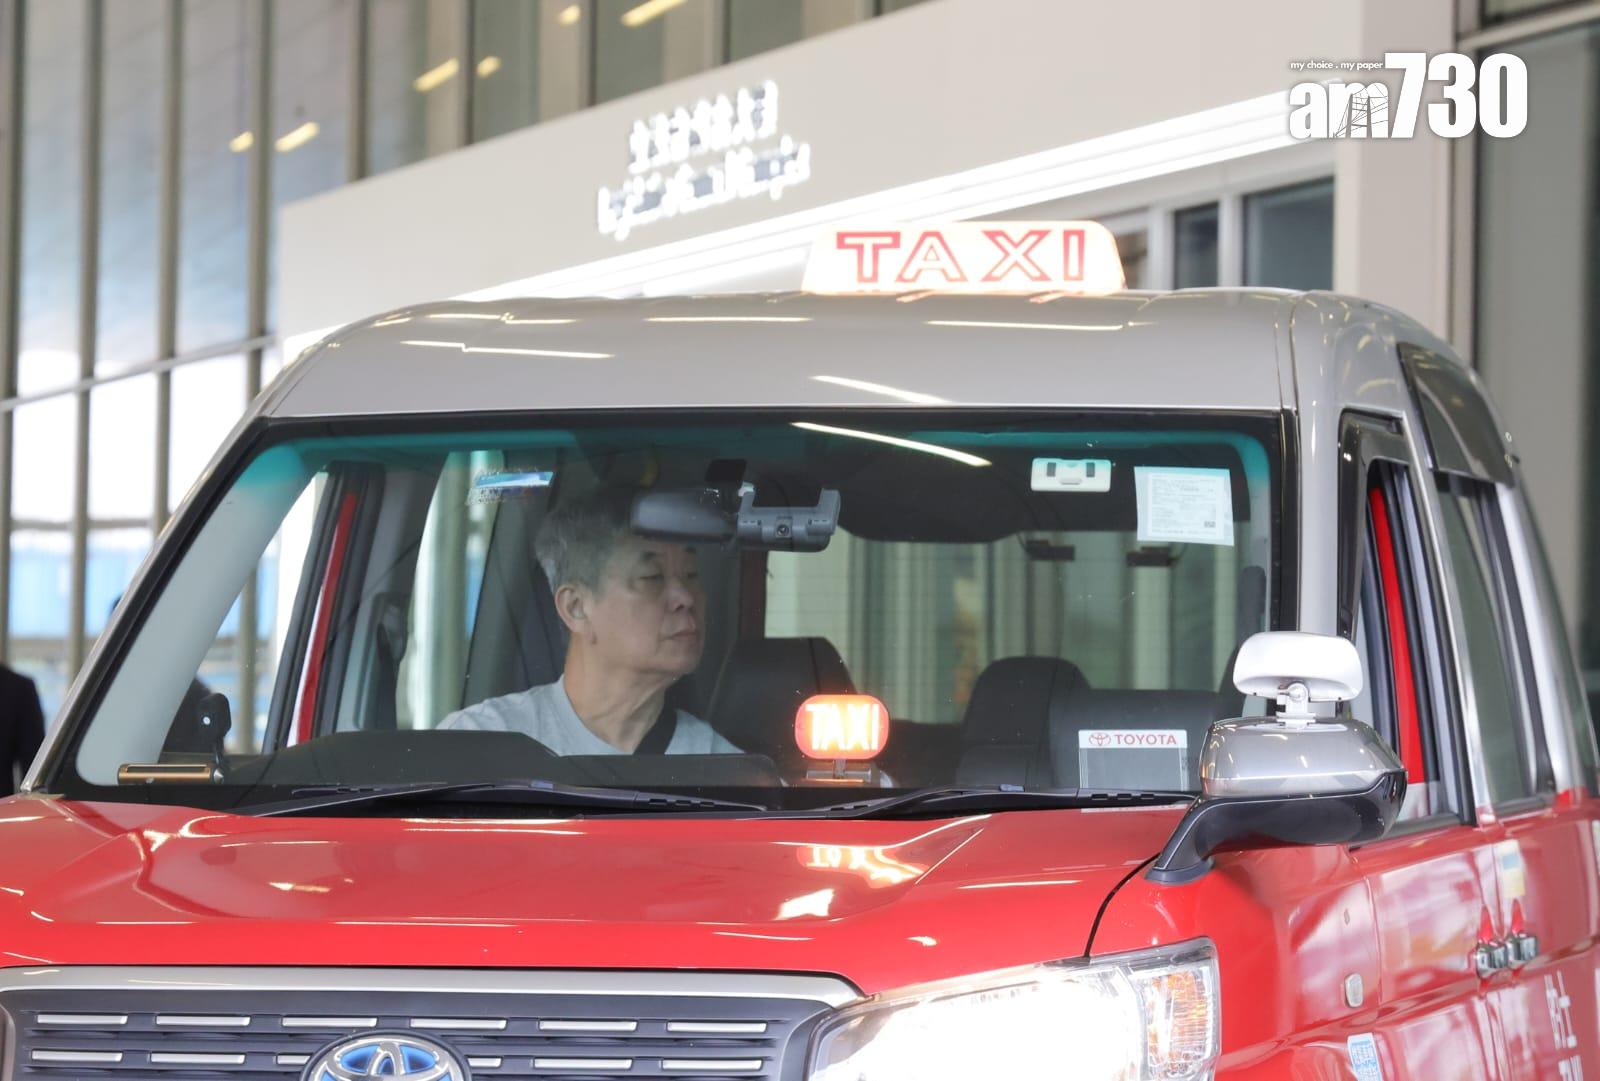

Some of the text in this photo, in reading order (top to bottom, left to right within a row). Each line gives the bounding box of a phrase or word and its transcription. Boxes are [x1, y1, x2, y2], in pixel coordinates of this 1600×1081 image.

[836, 229, 1086, 283] TAXI
[805, 703, 880, 751] TAXI
[1114, 733, 1177, 746] TOYOTA
